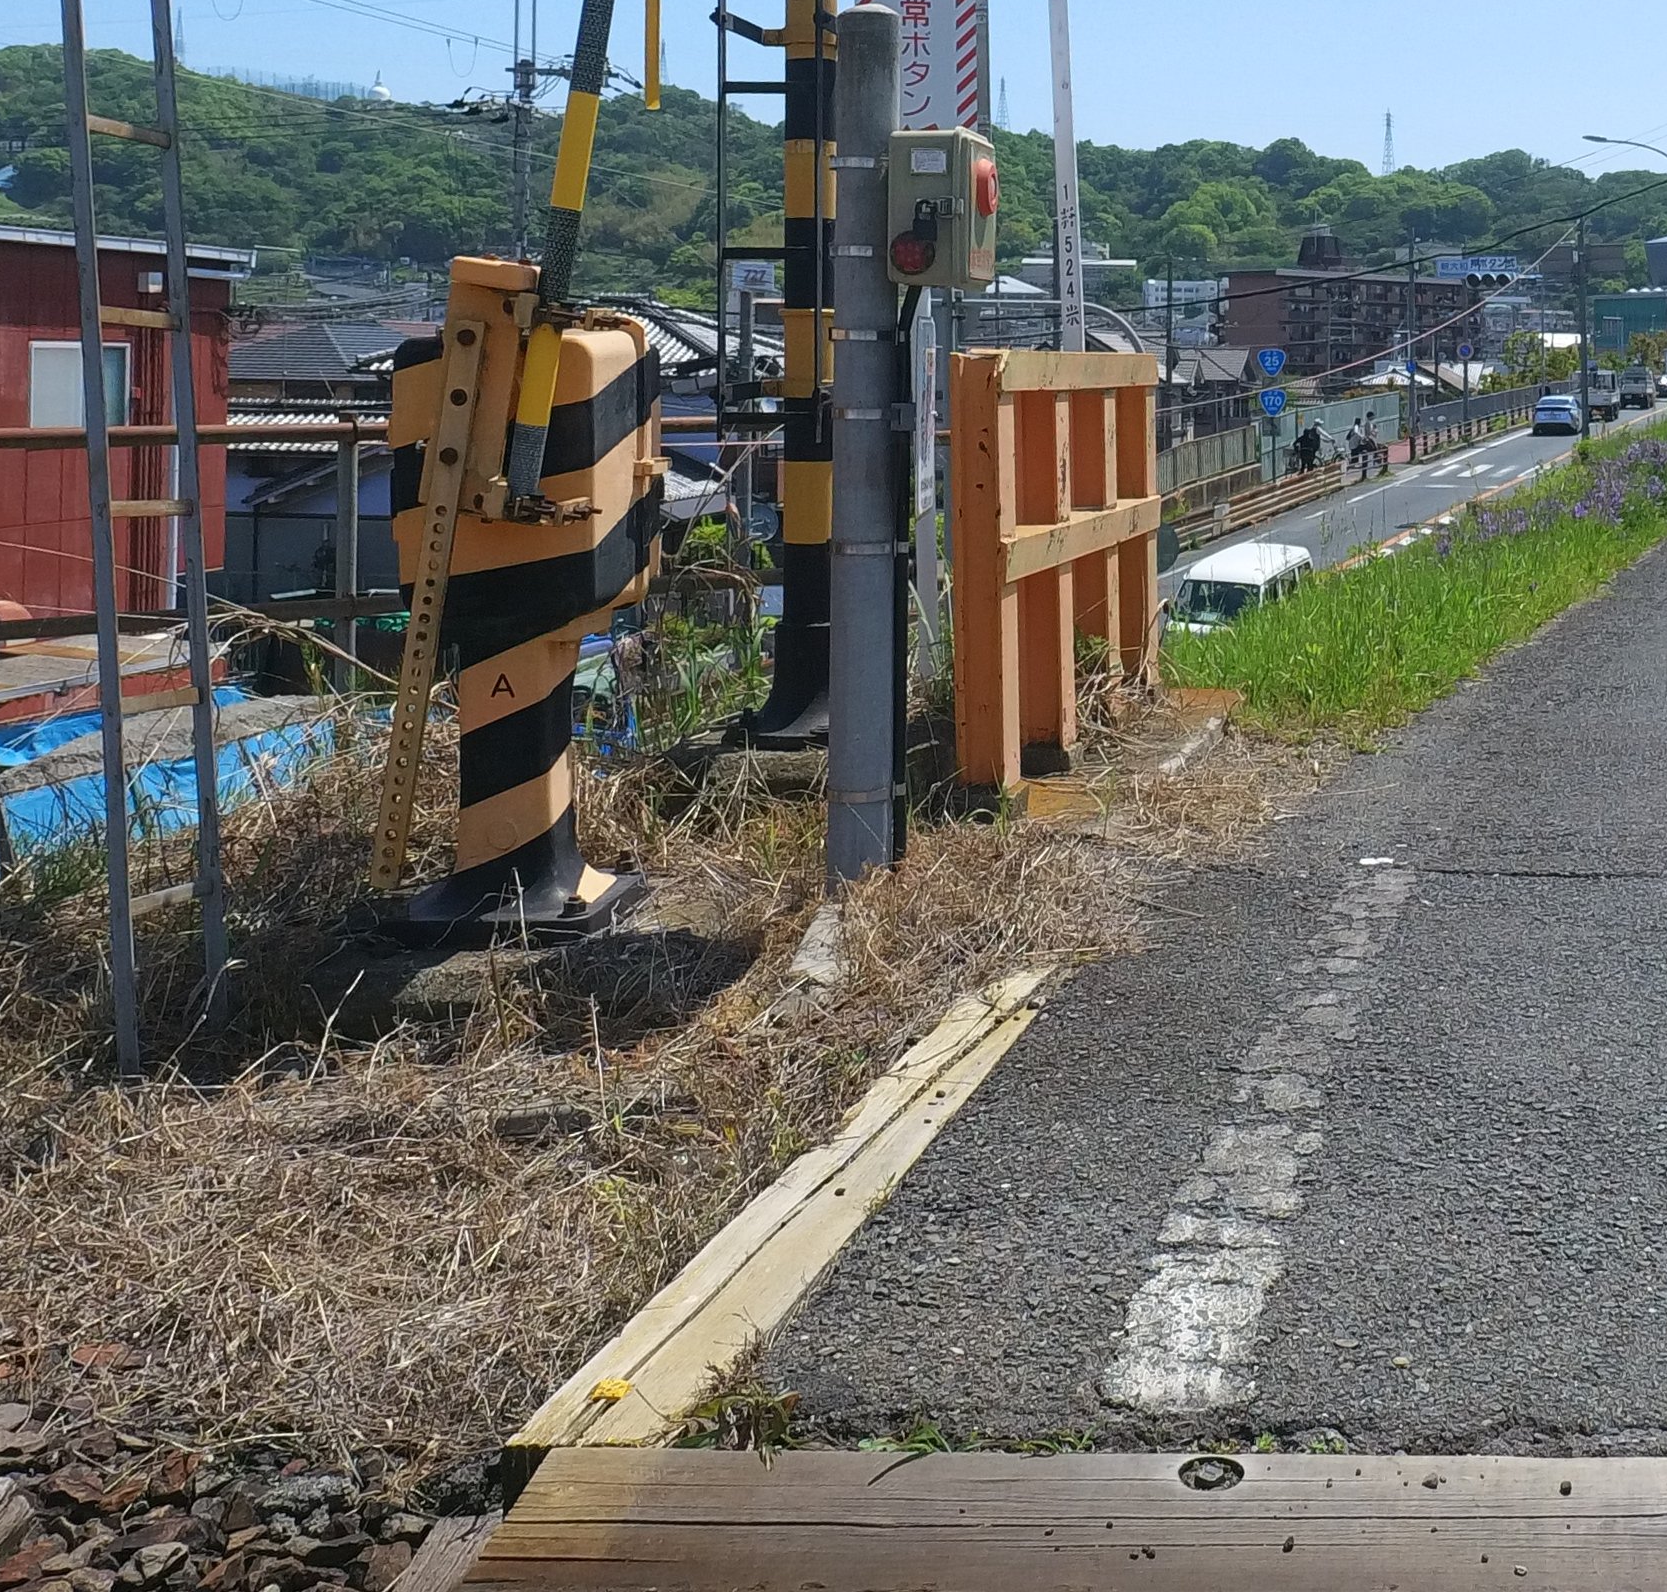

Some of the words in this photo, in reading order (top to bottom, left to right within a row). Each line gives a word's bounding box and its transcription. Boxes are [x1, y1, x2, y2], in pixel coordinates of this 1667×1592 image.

[1264, 356, 1279, 367] 25
[1263, 395, 1282, 407] 170
[490, 673, 515, 698] A
